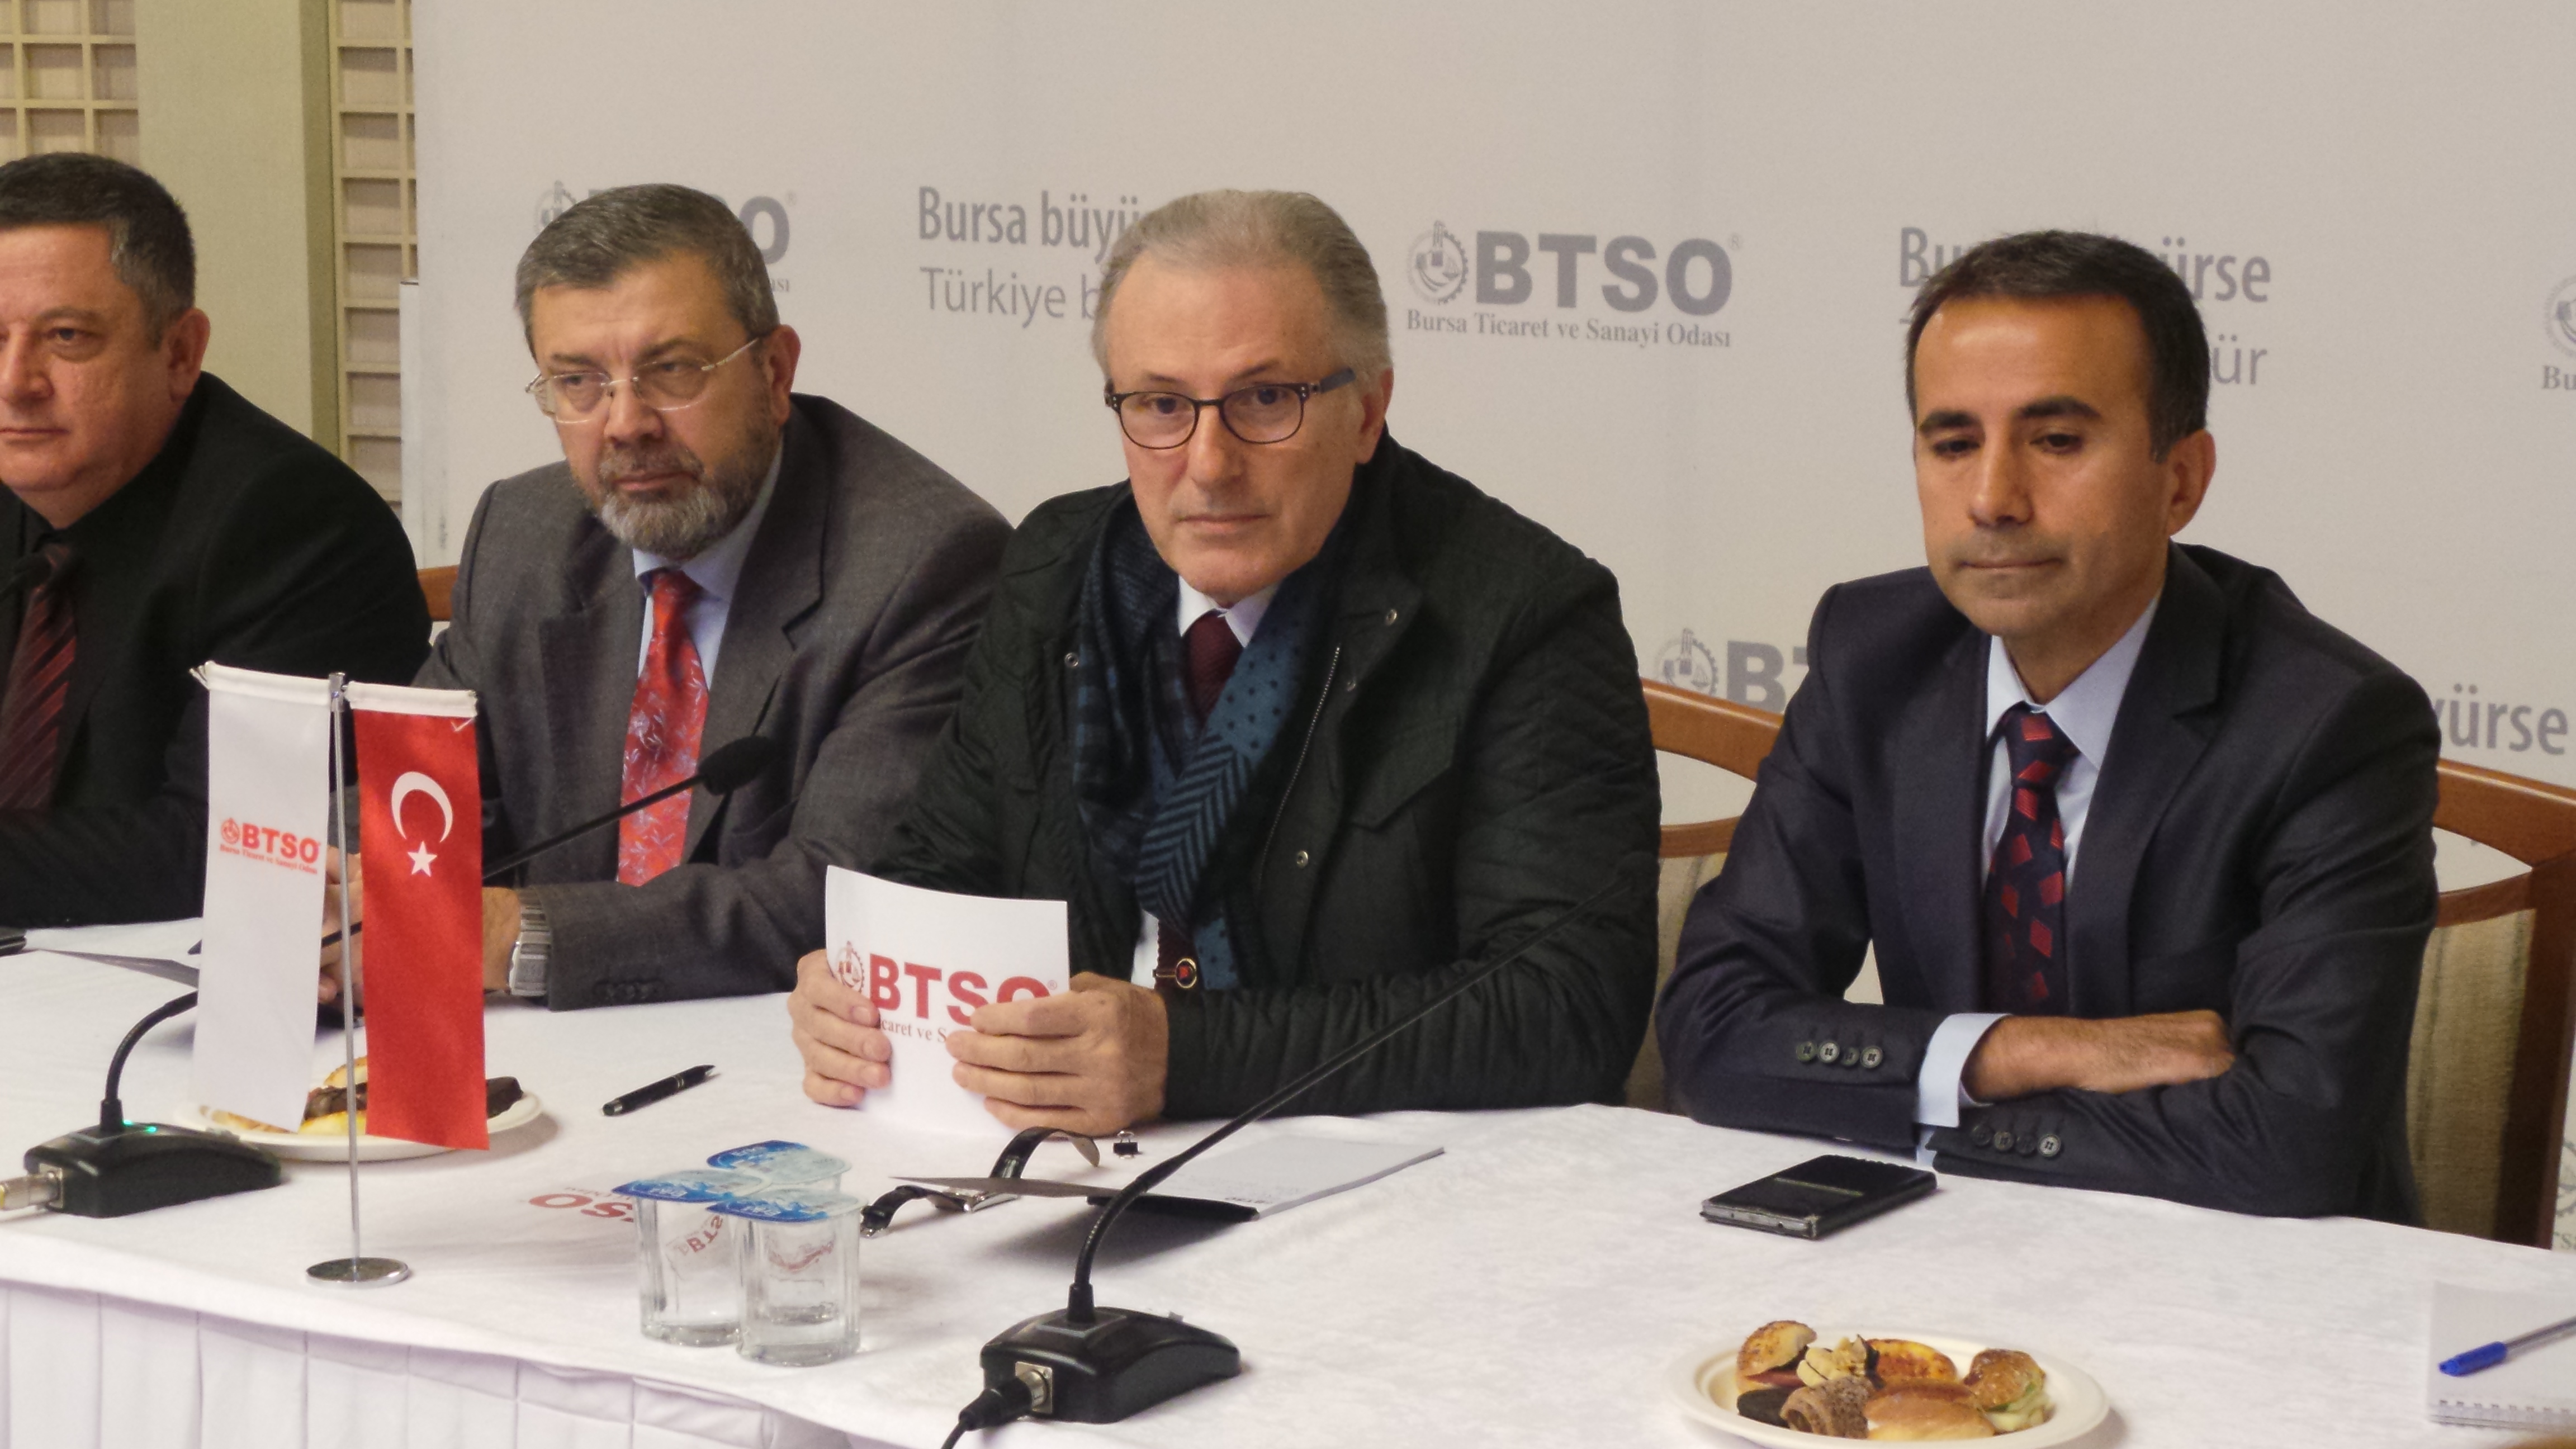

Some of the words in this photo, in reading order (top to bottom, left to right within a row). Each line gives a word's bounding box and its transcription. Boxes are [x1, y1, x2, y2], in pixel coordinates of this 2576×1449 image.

[918, 186, 1027, 245] Bursa
[1041, 190, 1140, 264] büyü
[920, 266, 1066, 329] Türkiye
[1476, 230, 1733, 316] BTSO
[2163, 236, 2271, 302] ürse
[1407, 309, 1467, 333] Bursa
[1474, 311, 1550, 338] Ticaret
[1558, 322, 1580, 339] ve
[1587, 319, 1659, 348] Sanayi
[1667, 323, 1731, 347] Odası
[2435, 683, 2568, 755] ürse
[242, 823, 319, 863] BTSO
[882, 1019, 912, 1038] caret
[917, 1027, 932, 1041] ve
[528, 1193, 634, 1223] SO
